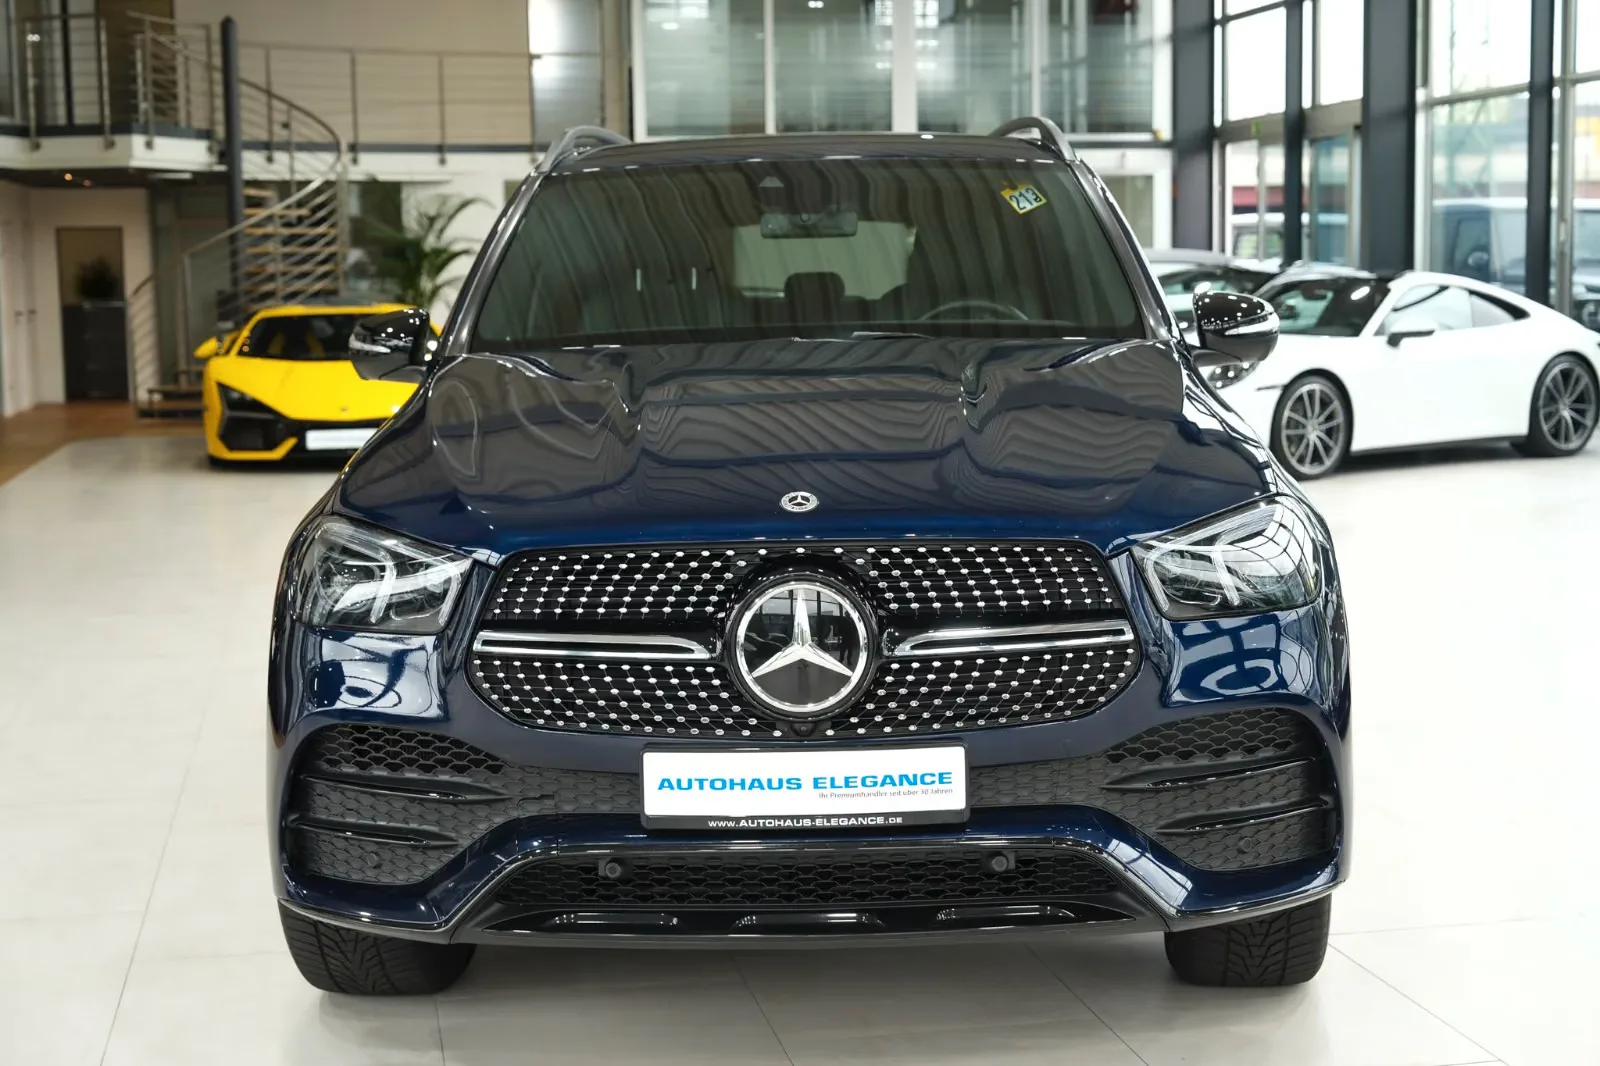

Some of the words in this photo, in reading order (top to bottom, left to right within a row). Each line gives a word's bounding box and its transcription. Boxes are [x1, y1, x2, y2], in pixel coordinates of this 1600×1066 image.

[658, 777, 802, 791] AUTOHAUS
[813, 771, 953, 789] ELEGANCE
[889, 789, 901, 797] seit
